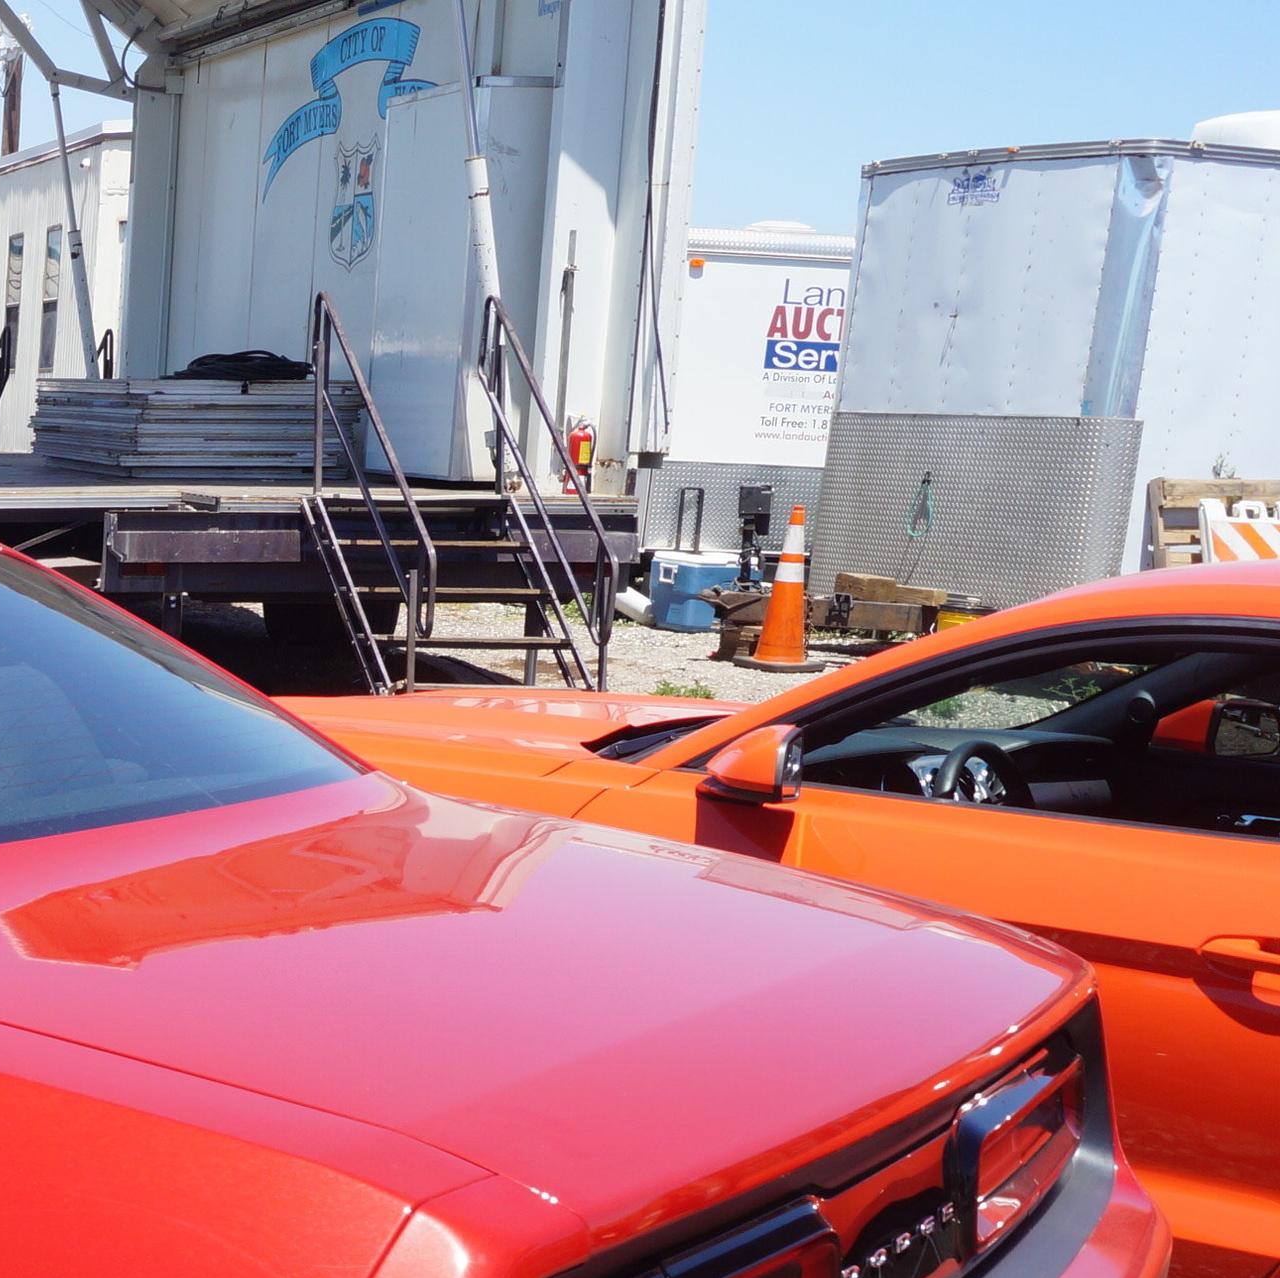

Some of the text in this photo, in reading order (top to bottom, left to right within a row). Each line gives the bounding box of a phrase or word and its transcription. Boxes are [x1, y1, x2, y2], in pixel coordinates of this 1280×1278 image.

[340, 26, 386, 63] CITY OF
[276, 104, 338, 162] FORT MYERS
[783, 278, 845, 307] Lan
[762, 372, 770, 381] A
[773, 372, 810, 383] Division
[813, 374, 826, 384] Of
[769, 402, 798, 413] FORT
[760, 416, 778, 427] Toll
[781, 417, 807, 429] Free:
